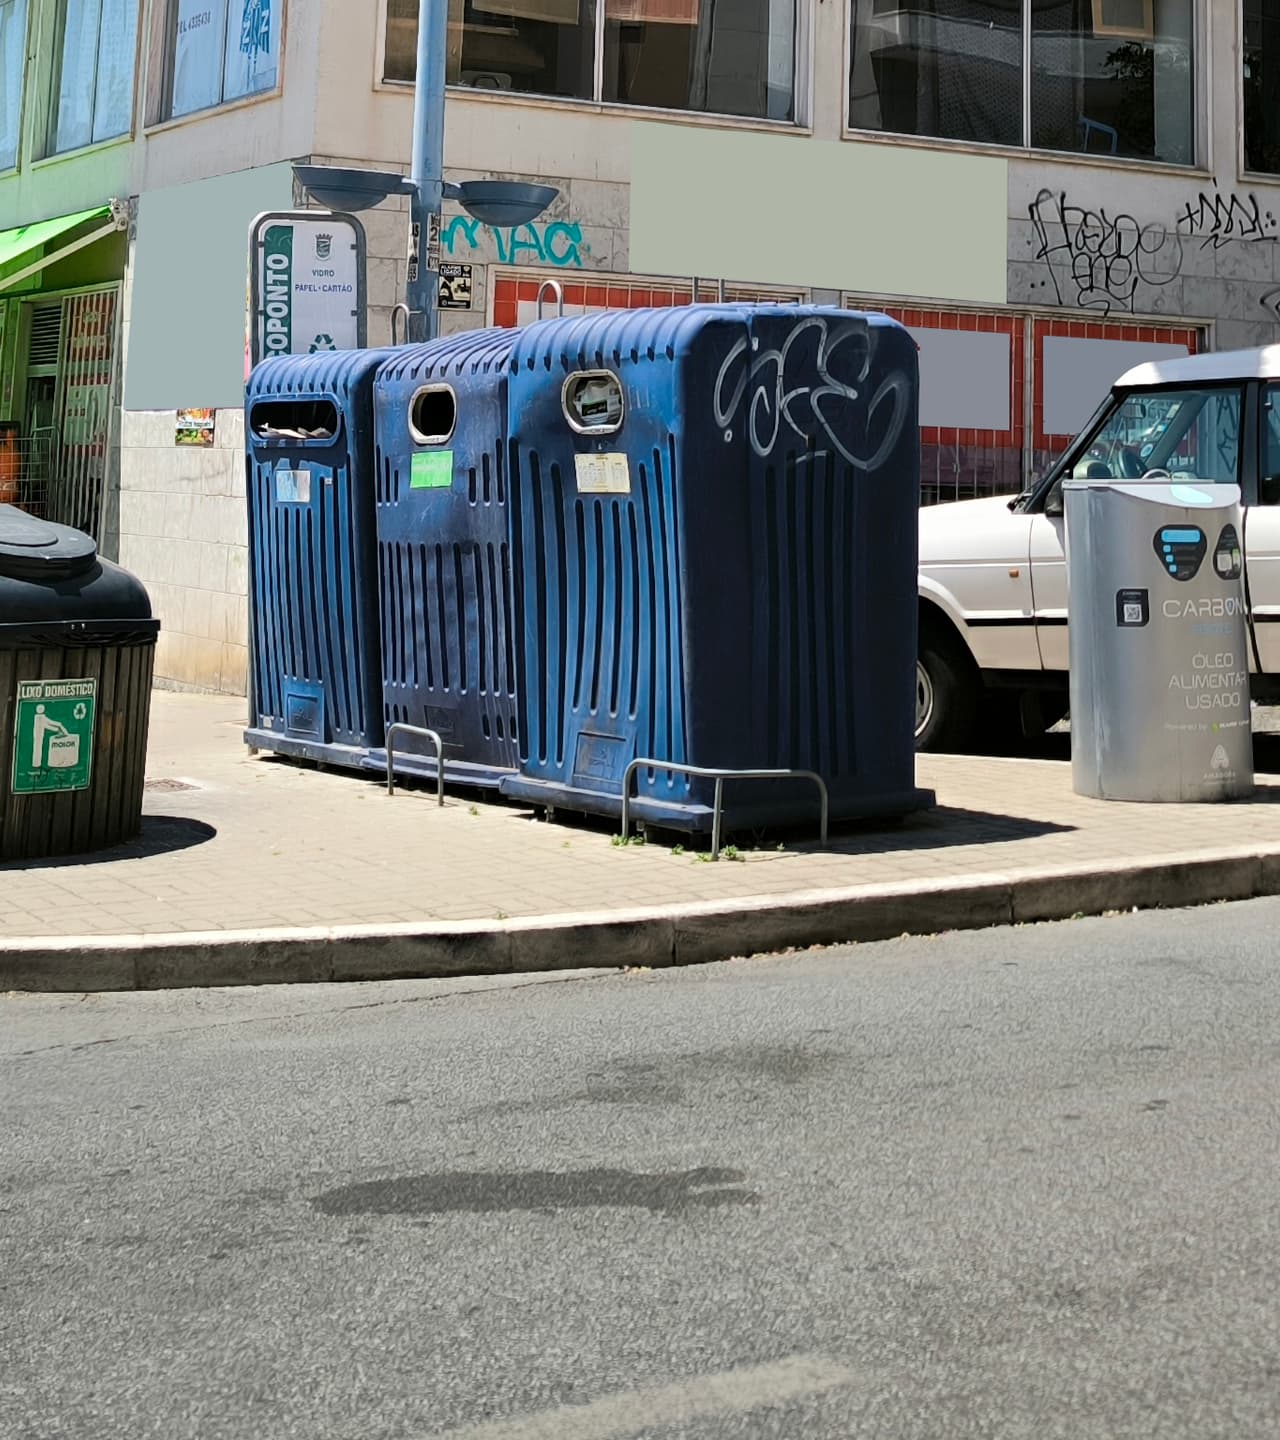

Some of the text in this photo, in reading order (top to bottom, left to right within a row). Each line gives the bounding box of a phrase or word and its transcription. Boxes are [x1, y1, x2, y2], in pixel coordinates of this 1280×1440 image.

[311, 269, 335, 277] VIDRO
[266, 253, 289, 359] COPONTO
[1192, 651, 1234, 669] ÓLEO
[1169, 670, 1247, 690] ALIMENTAR
[21, 682, 94, 698] LIXO DOMÉSTICO
[1185, 692, 1241, 709] USADO
